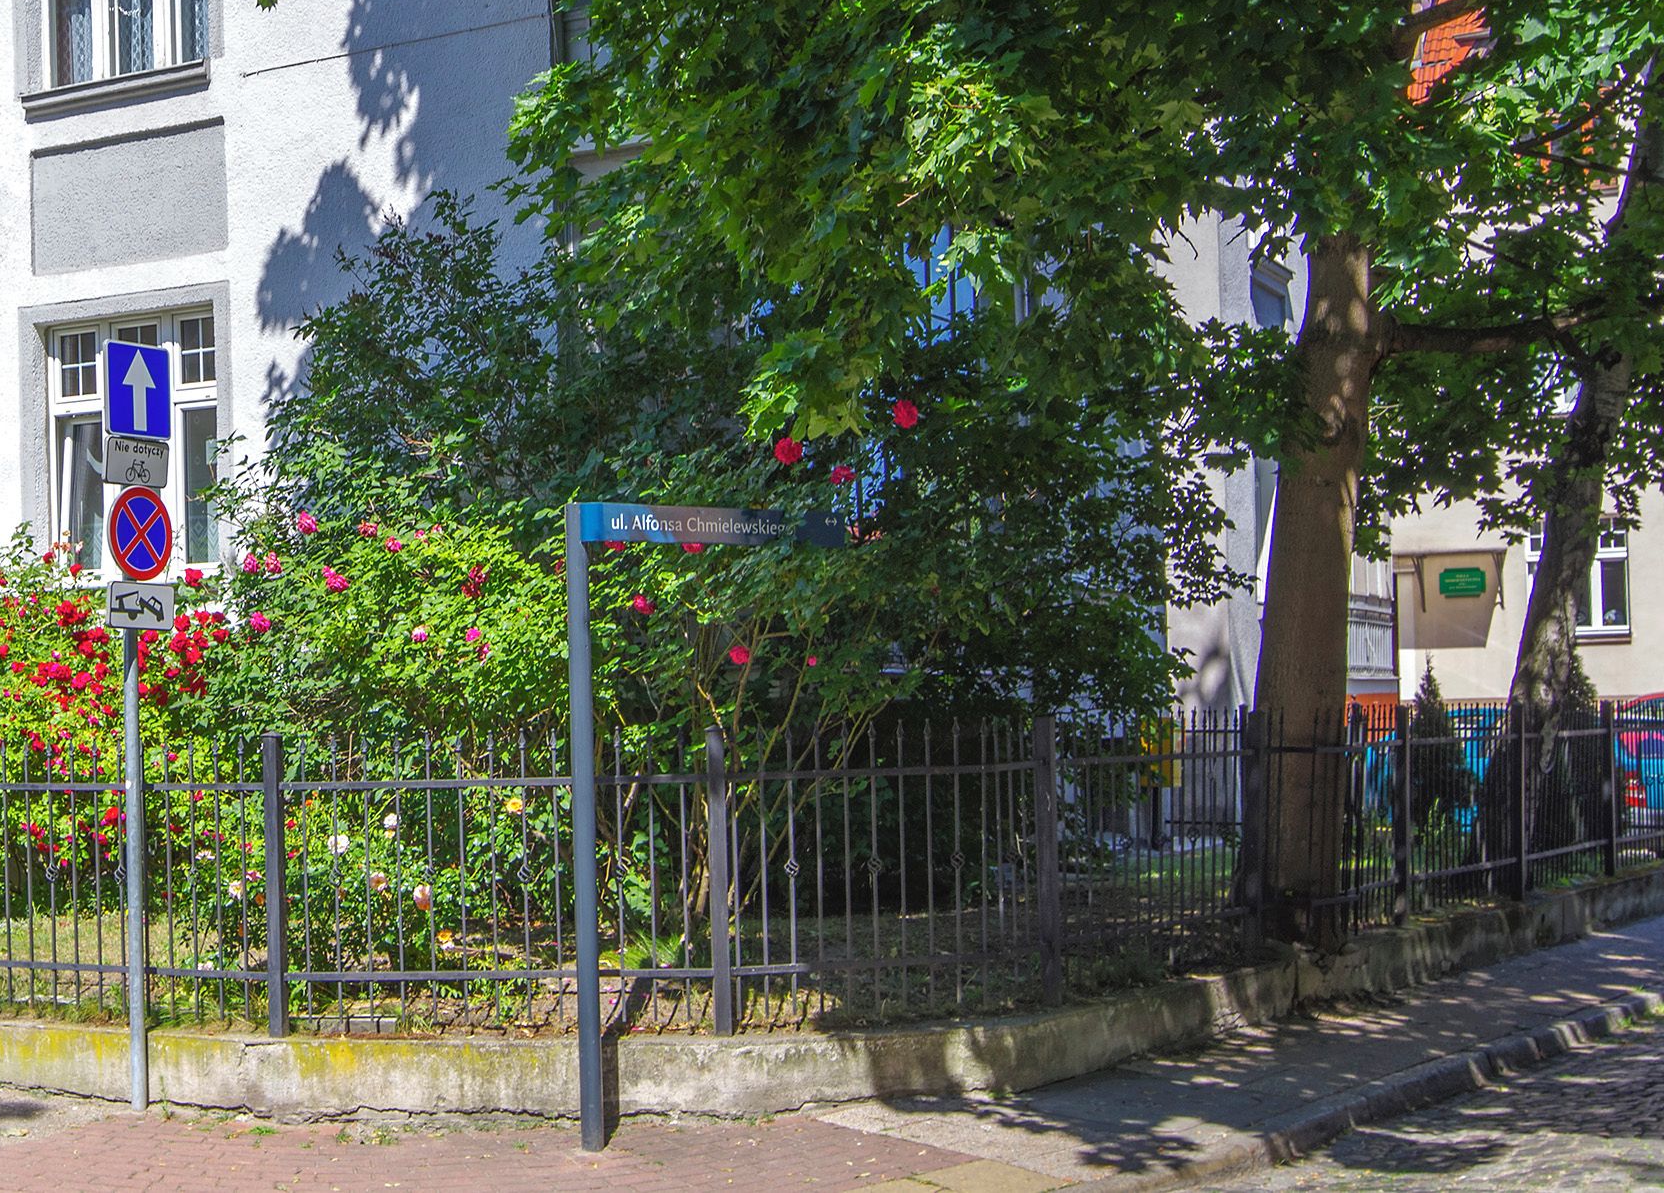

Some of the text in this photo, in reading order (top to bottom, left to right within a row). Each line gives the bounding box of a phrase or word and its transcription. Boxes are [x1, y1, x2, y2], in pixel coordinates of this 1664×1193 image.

[115, 440, 164, 459] Nie dotyczy
[611, 514, 628, 531] ul.
[632, 515, 683, 532] Alfonsa
